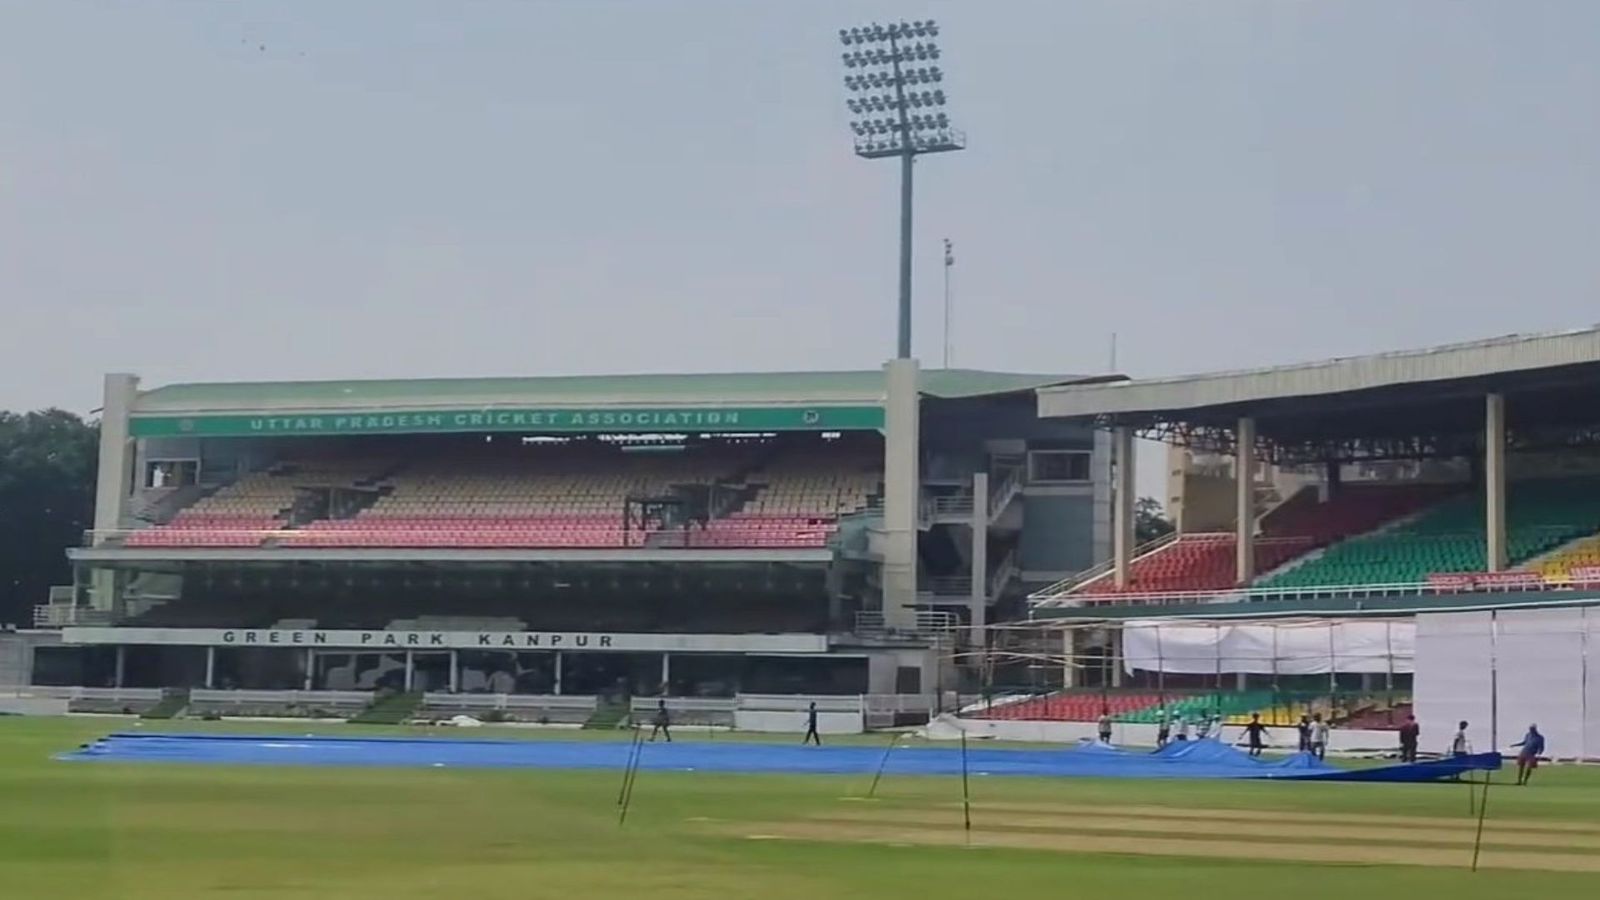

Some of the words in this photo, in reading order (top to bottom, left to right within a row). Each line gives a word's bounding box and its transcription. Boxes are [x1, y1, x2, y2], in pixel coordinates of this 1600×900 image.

[250, 418, 323, 430] UTTAR
[335, 415, 441, 428] PRADESH
[454, 412, 557, 426] CRICKET
[571, 411, 740, 424] ASSOCIATION
[223, 631, 327, 644] GREEN
[361, 634, 444, 645] PARK
[479, 635, 612, 648] KANPUR
